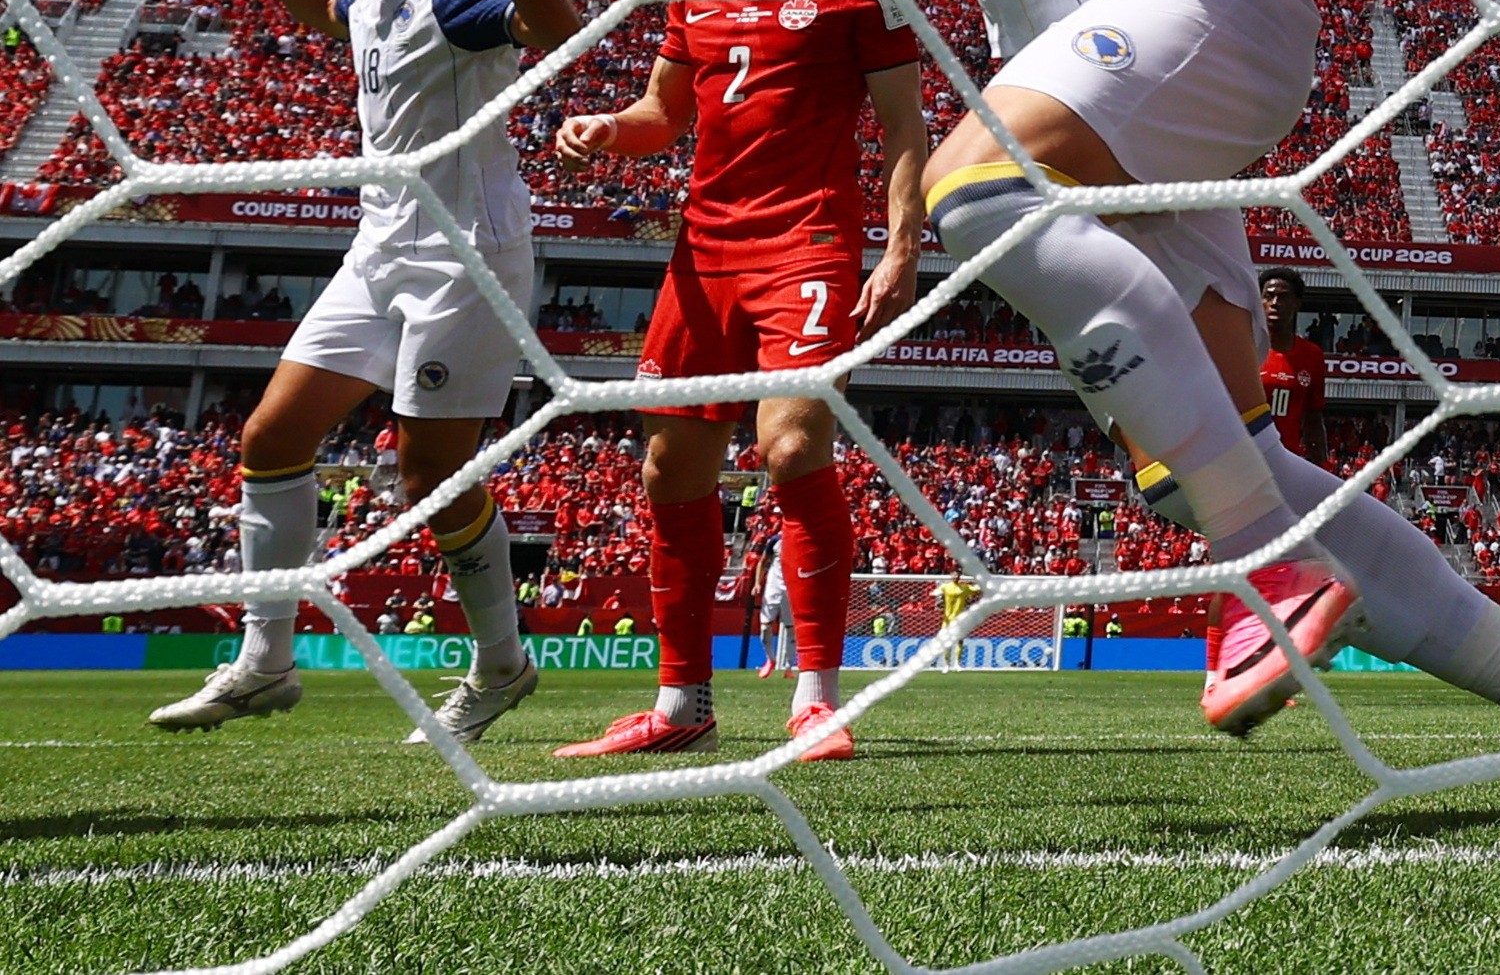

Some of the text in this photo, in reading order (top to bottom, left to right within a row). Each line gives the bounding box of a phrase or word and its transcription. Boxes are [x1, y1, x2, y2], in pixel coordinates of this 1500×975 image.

[361, 47, 381, 95] 18
[722, 45, 751, 104] 2
[232, 201, 297, 218] COUPE
[300, 204, 328, 219] DU
[529, 213, 574, 229] 026
[1259, 243, 1452, 265] FIFA WOD CUP 2026
[800, 280, 829, 337] 2
[900, 346, 923, 360] DE
[926, 347, 944, 361] LA
[951, 347, 989, 363] FIFA
[993, 349, 1055, 364] 2026
[1271, 388, 1291, 417] 10
[522, 637, 655, 669] ARTNER
[861, 638, 1052, 669] armco
